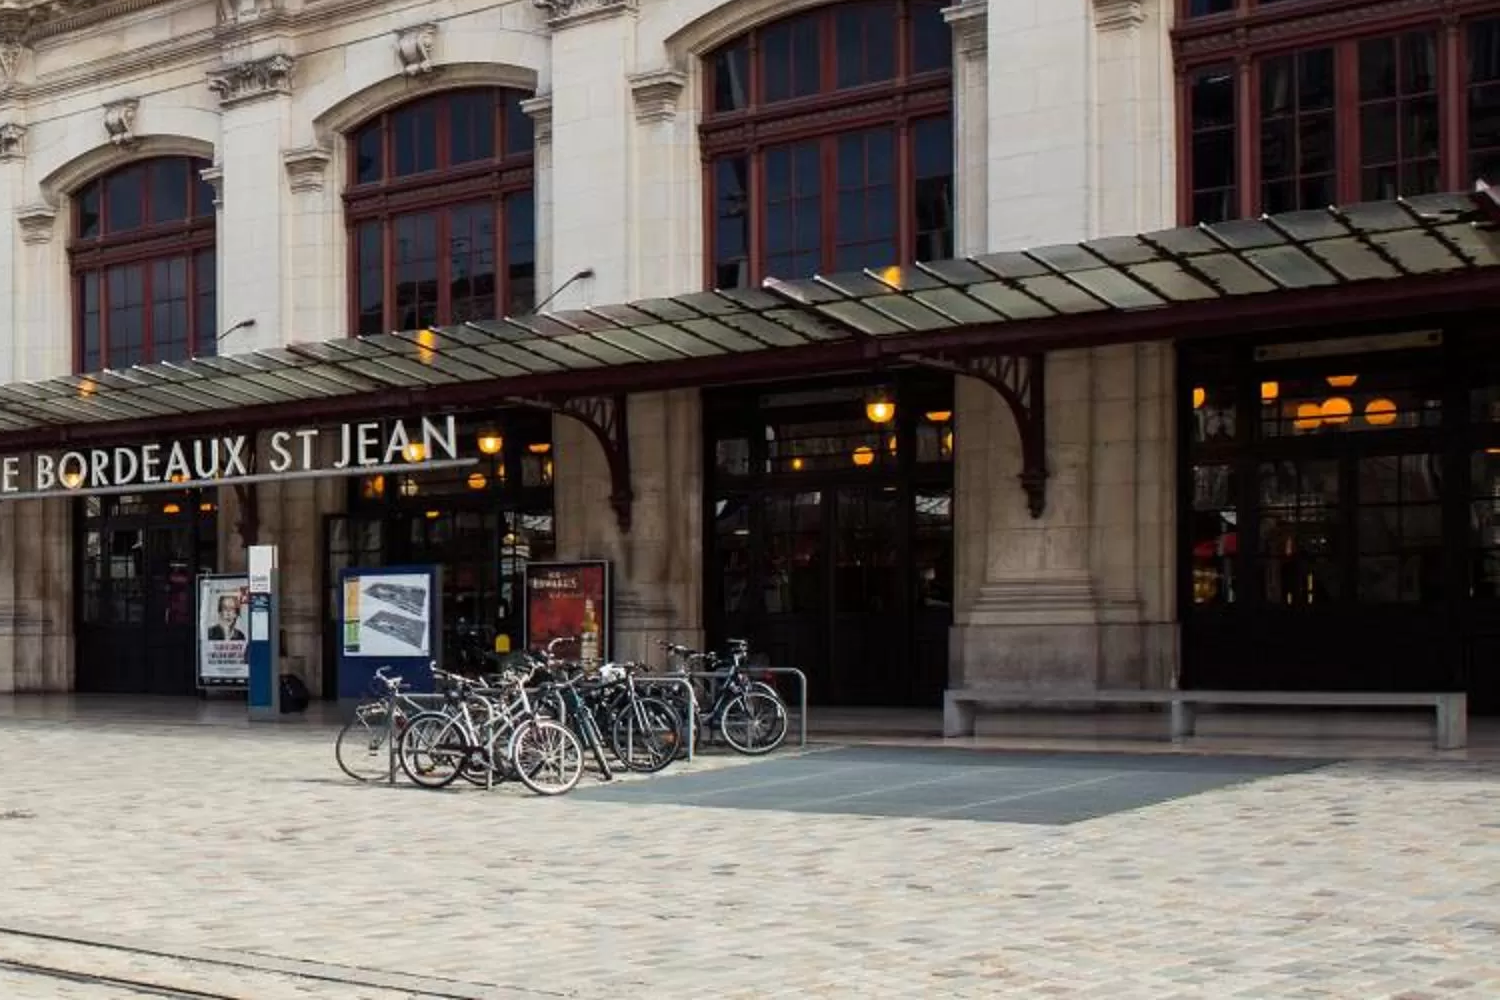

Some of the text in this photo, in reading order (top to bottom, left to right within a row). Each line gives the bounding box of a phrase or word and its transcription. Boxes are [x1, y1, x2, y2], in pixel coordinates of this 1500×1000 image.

[37, 435, 249, 491] BORDEAUX
[270, 430, 319, 473] ST
[333, 416, 459, 468] JEAN
